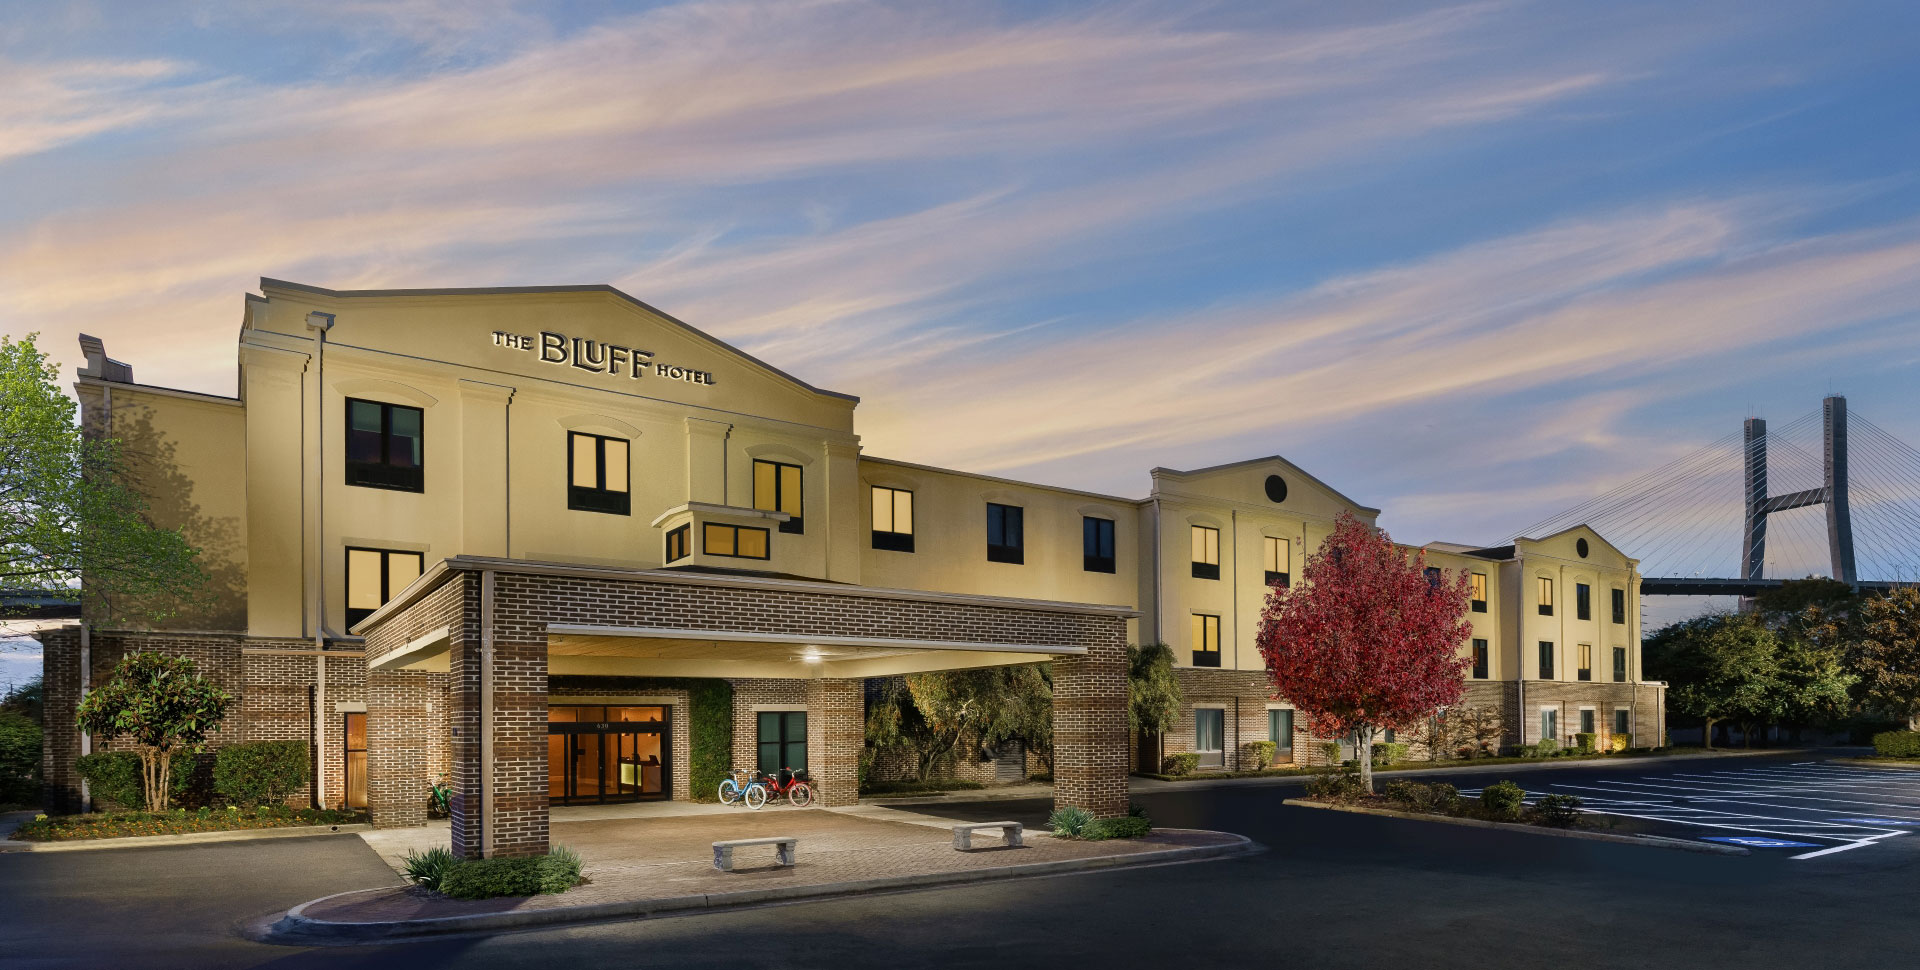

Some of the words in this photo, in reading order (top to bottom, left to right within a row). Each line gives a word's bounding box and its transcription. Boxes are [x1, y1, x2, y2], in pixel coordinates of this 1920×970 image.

[491, 331, 534, 351] THE
[539, 330, 655, 378] BLUFF
[656, 363, 716, 385] HOTEL
